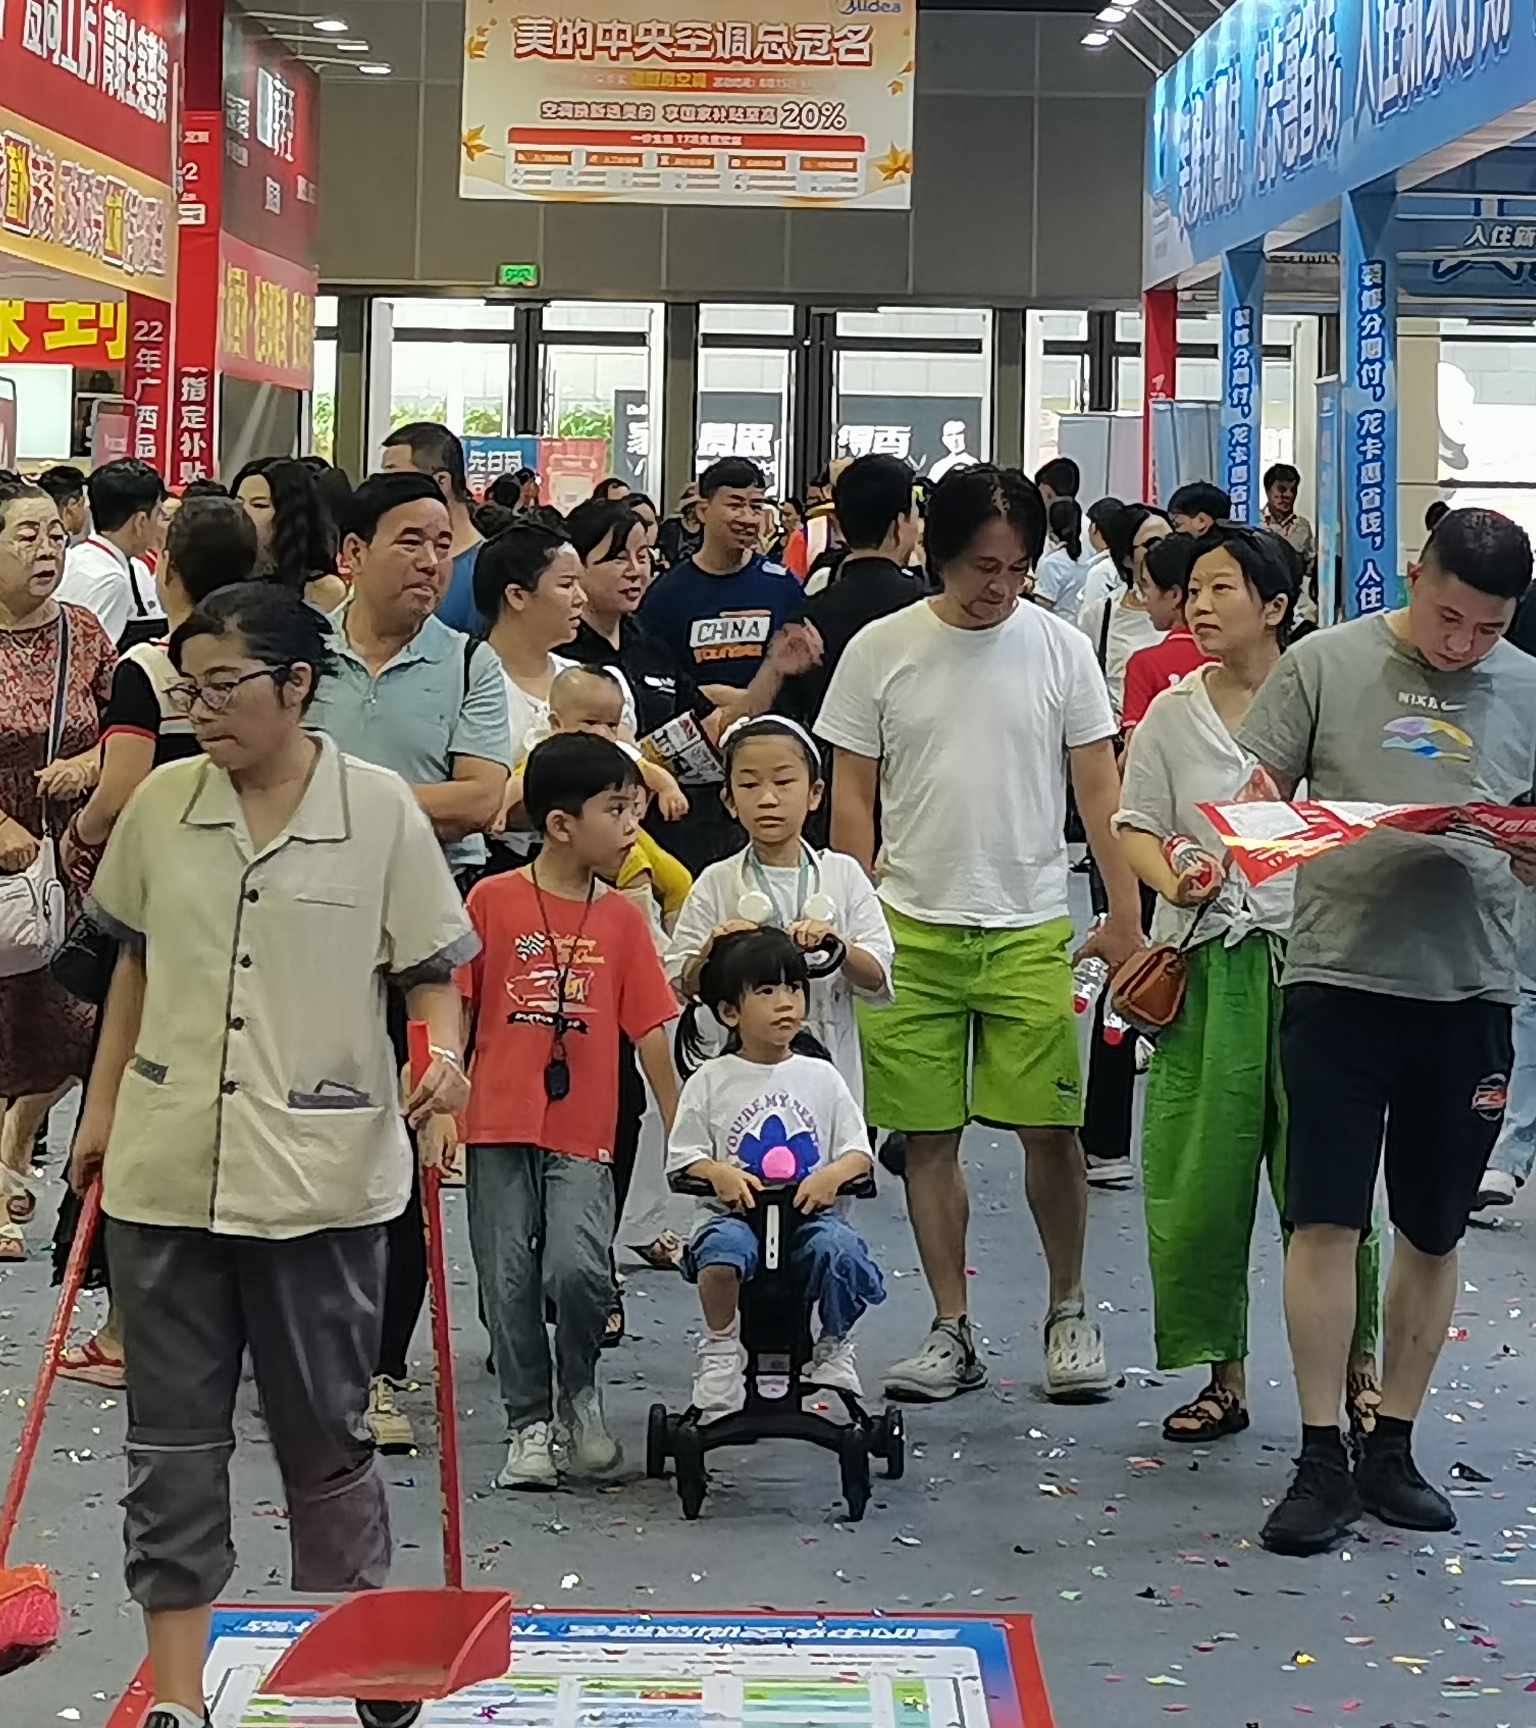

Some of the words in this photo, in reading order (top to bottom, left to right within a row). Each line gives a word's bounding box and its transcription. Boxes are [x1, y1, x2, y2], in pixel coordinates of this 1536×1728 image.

[513, 15, 874, 66] 美的中央空调总冠名
[133, 320, 165, 470] 22年广西品
[179, 366, 210, 486] 指定补贴
[696, 618, 762, 643] CHINA
